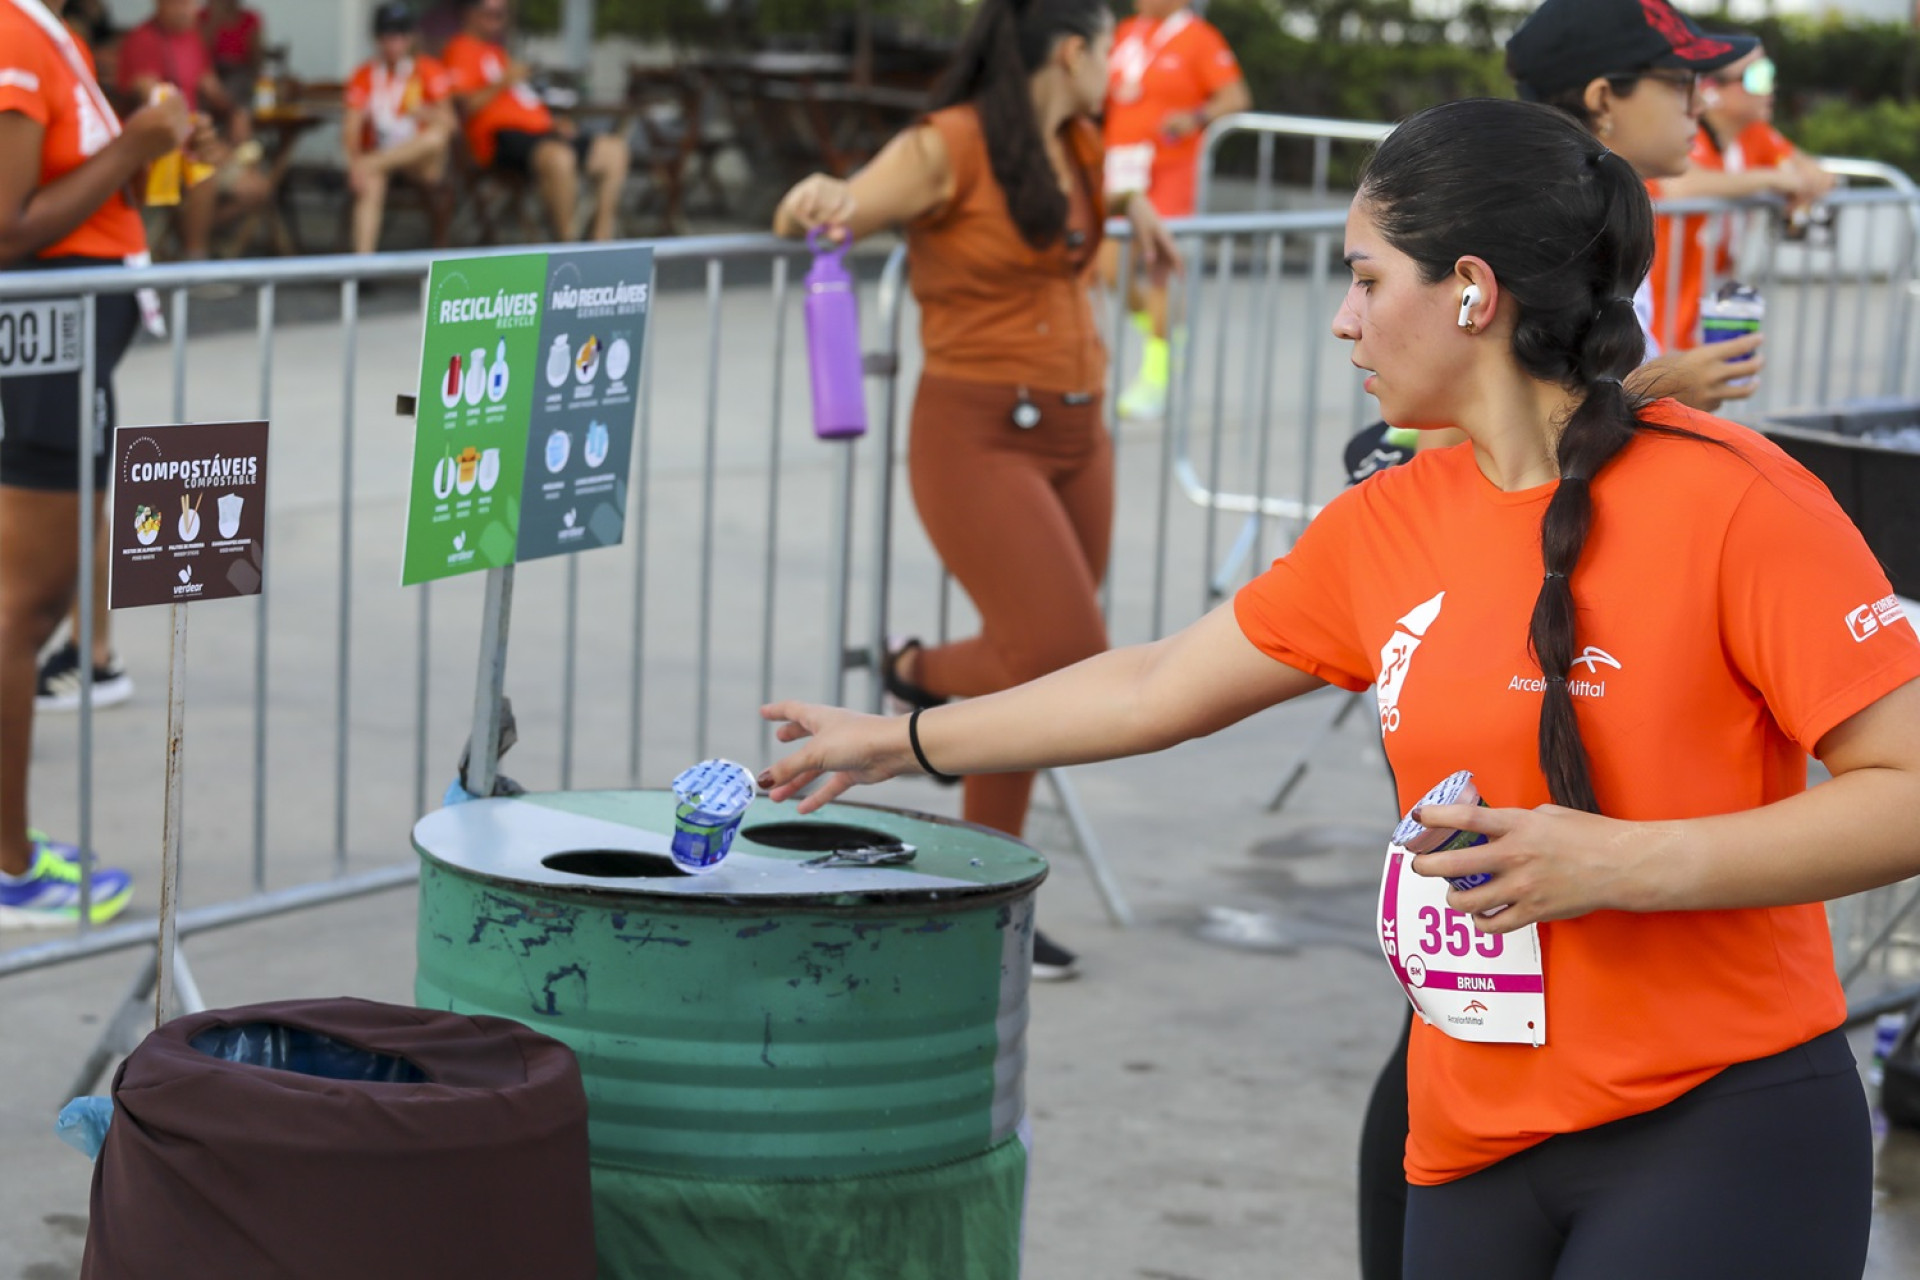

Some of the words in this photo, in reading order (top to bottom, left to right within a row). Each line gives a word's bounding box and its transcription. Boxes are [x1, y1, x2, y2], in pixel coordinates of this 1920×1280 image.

[439, 288, 538, 324] RECICLÁVEIS
[552, 284, 577, 310] NÃO
[578, 281, 648, 306] RECICLÁVEIS
[496, 314, 535, 329] RECYCLE
[131, 453, 257, 482] COMPOSTÁVEIS
[184, 474, 256, 489] COMPOSTABLE
[173, 582, 203, 594] verdear
[1508, 675, 1605, 697] ArcelMittal
[1418, 905, 1504, 958] 355
[1457, 976, 1496, 991] BRUNA
